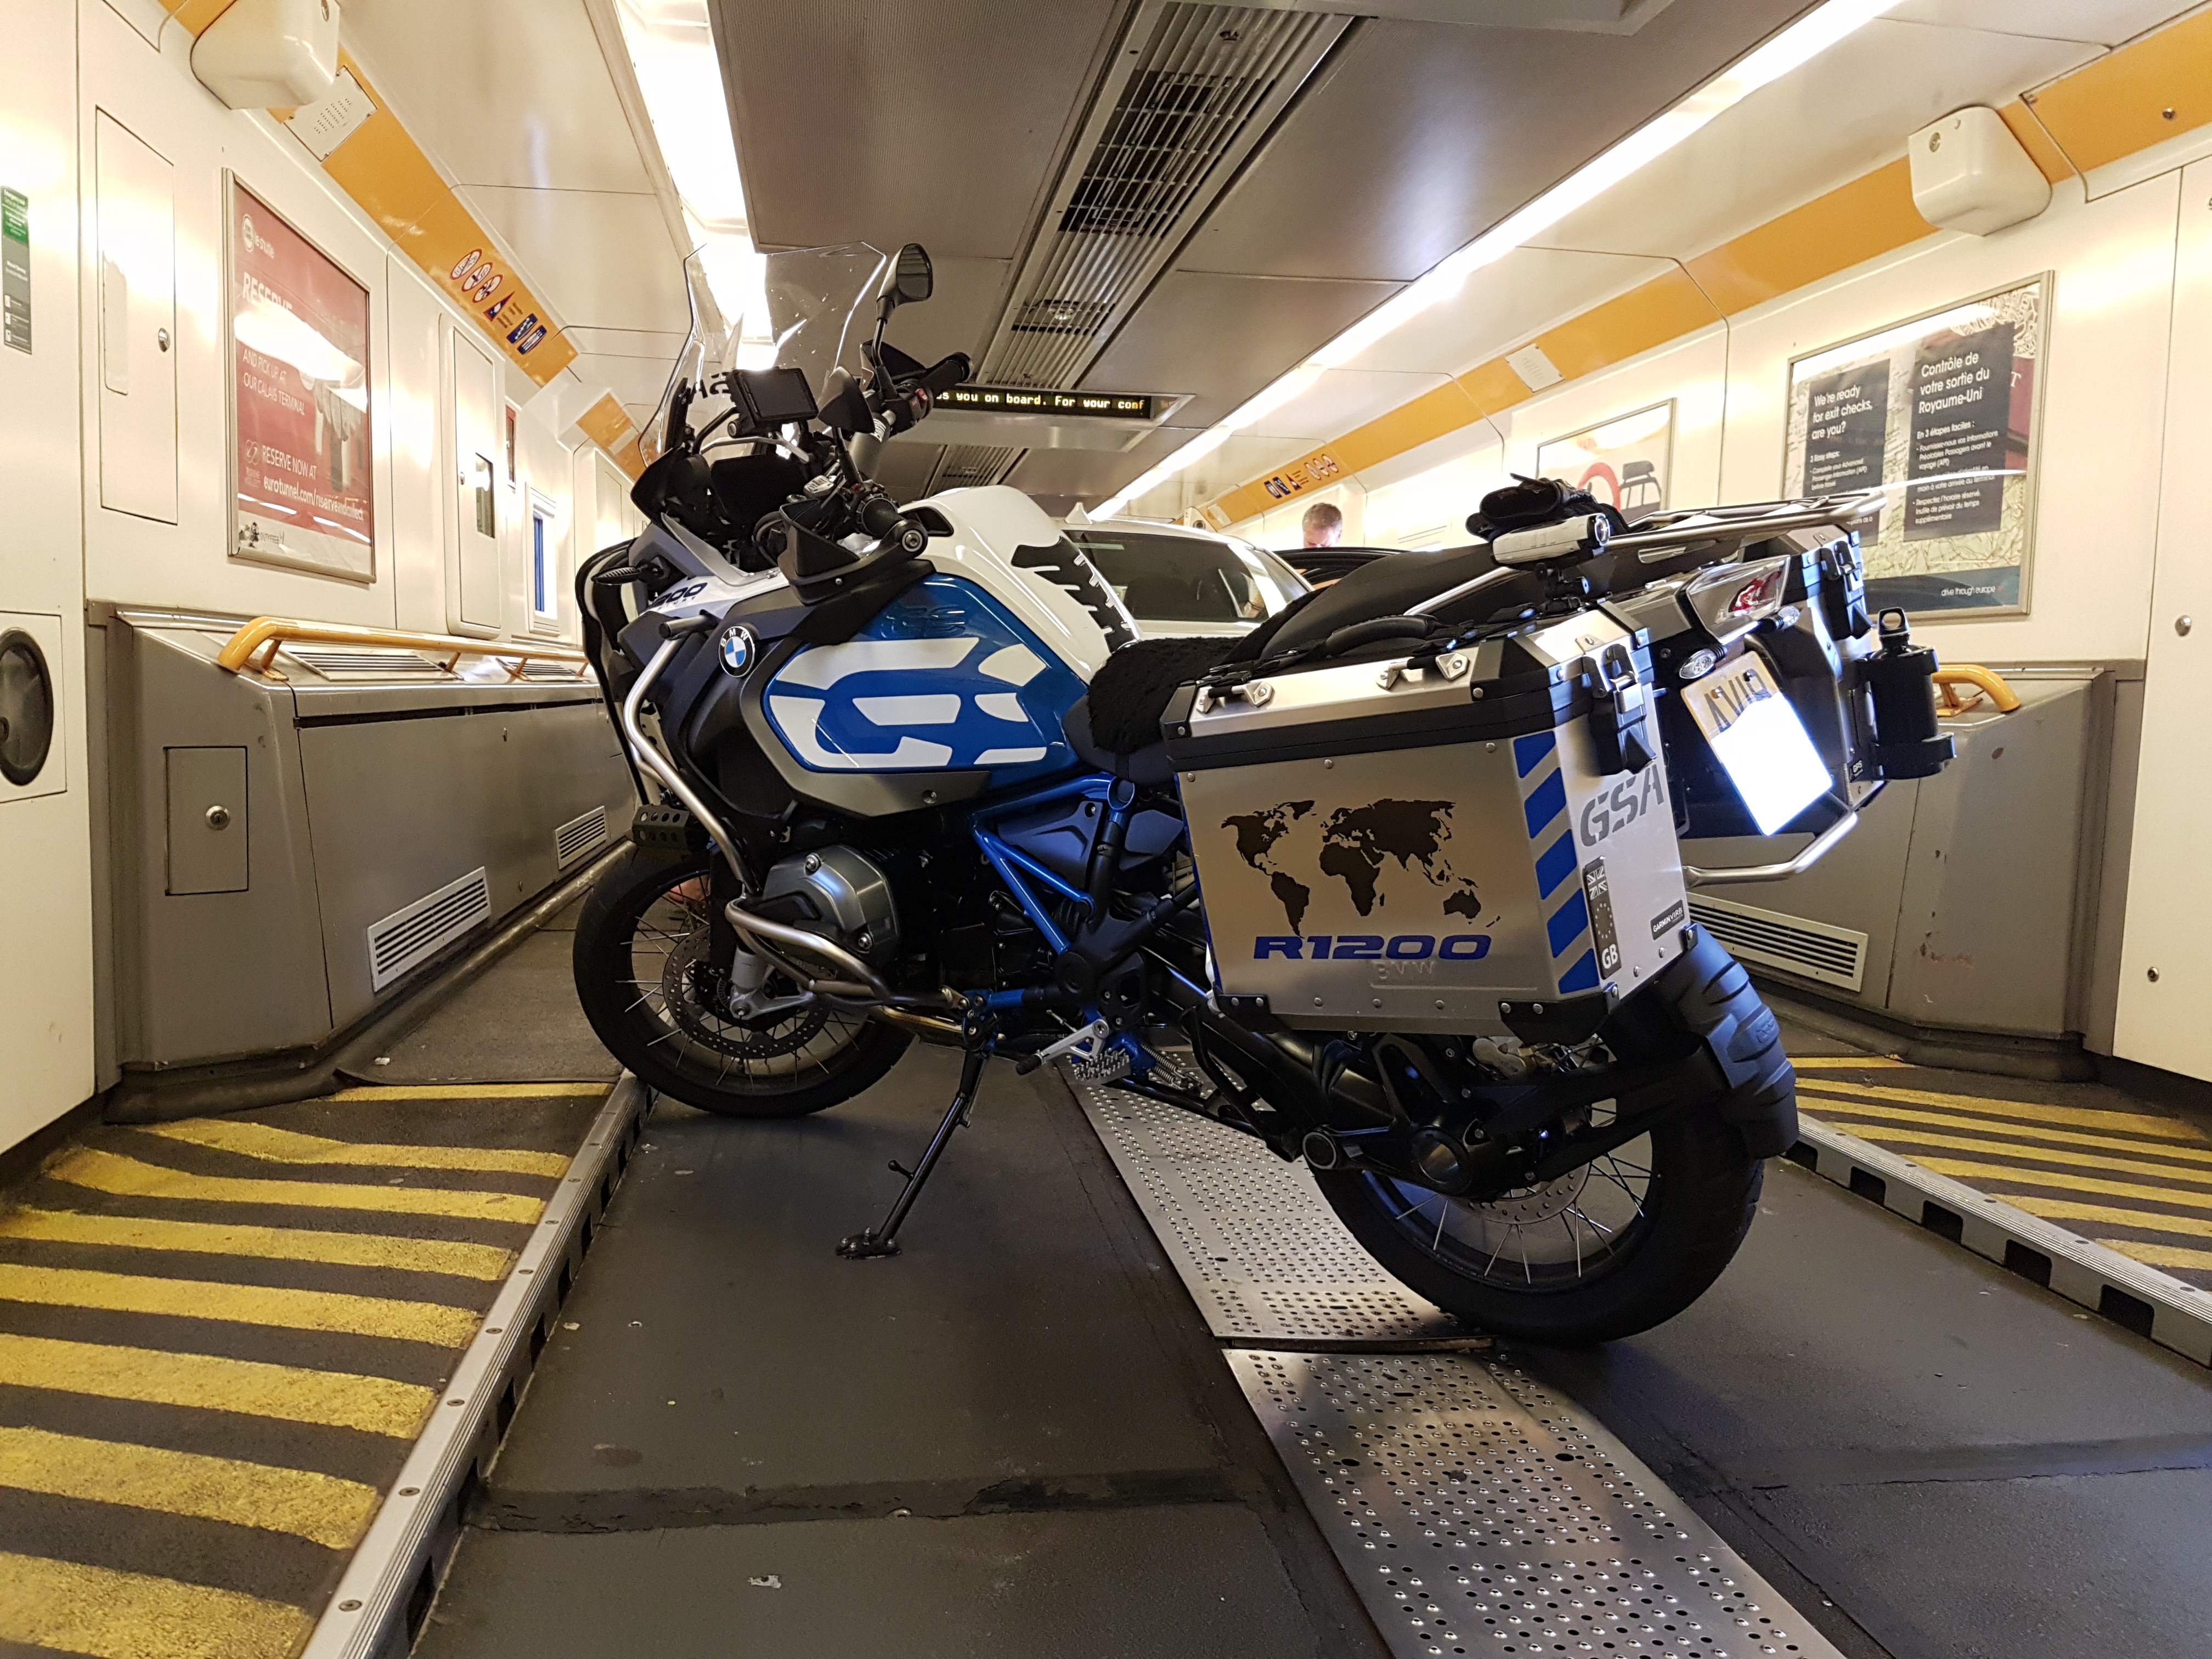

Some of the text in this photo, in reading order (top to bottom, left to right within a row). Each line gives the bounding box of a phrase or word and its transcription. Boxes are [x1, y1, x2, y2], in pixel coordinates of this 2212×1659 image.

[242, 348, 287, 384] AND PICK UP AT
[1921, 352, 1979, 377] Contrôle de
[1836, 384, 1861, 401] ready
[1920, 366, 1990, 396] votre sortie du
[244, 372, 305, 416] OUR CALAIS TERMINAL
[956, 393, 978, 402] you
[985, 393, 998, 403] on
[1006, 393, 1046, 405] board.
[1055, 396, 1076, 407] For
[1083, 399, 1110, 408] your
[1918, 386, 1983, 414] Royaume-Uni
[1813, 412, 1823, 424] for
[1825, 406, 1840, 421] exit
[1812, 421, 1846, 439] are you?
[1917, 431, 1925, 439] En
[1930, 426, 1950, 437] étapes
[1951, 422, 1971, 432] faciles
[262, 445, 317, 480] RESERVE NOW AT
[1975, 586, 1996, 594] europe
[720, 628, 749, 648] BMW
[1580, 763, 1664, 847] GSA
[1253, 934, 1492, 961] R1200
[1601, 943, 1618, 969] GB
